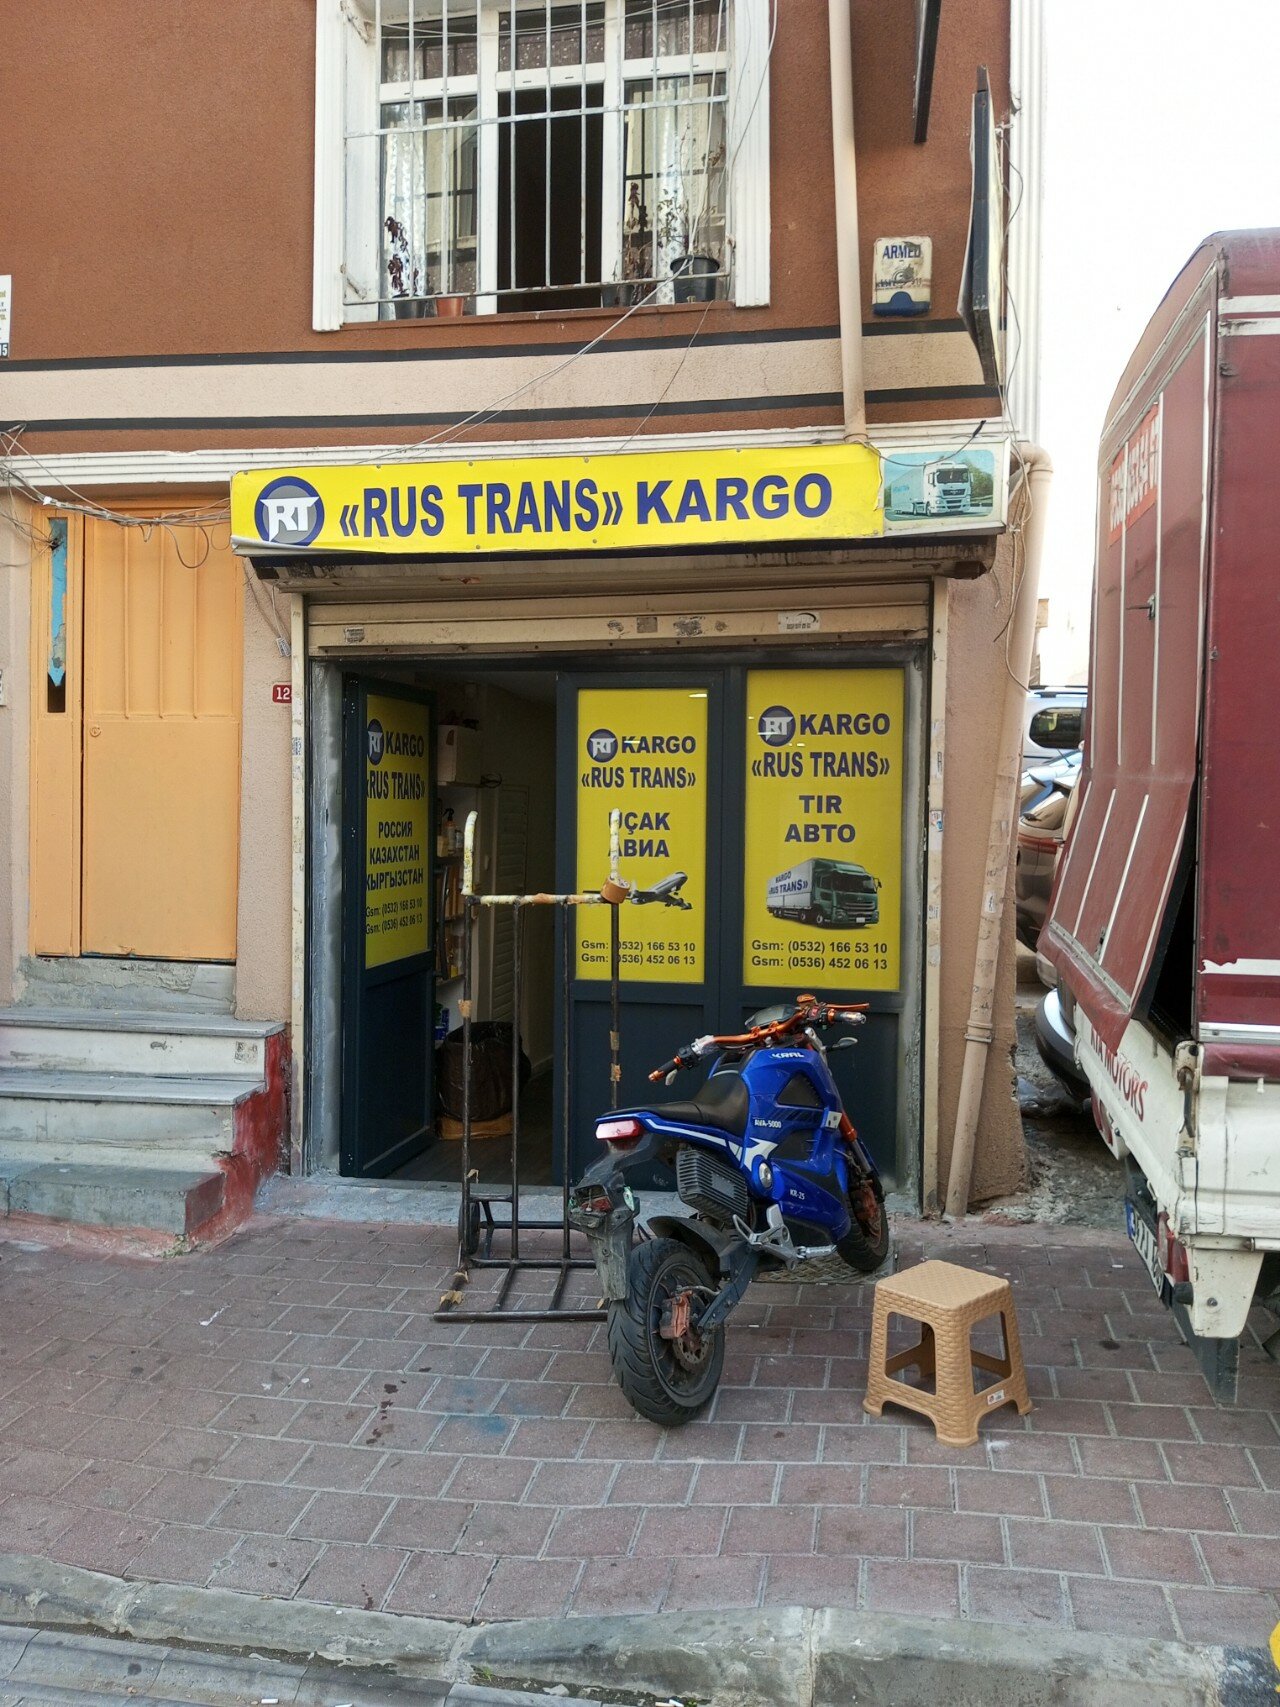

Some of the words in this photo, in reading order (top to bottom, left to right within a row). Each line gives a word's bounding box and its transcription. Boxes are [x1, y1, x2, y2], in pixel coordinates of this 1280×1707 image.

[883, 244, 921, 259] ARMED
[339, 485, 444, 537] «RUS
[458, 478, 624, 535] TRANS»
[636, 472, 832, 525] KARGO
[276, 687, 291, 700] 12
[800, 713, 890, 735] KARGO
[386, 731, 424, 757] KARGO
[621, 736, 696, 754] KARGO
[752, 751, 803, 777] «RUS
[810, 751, 890, 777] TRANS»
[581, 767, 624, 788] «RUS
[630, 767, 696, 788] TRANS»
[799, 795, 843, 814] TIR
[378, 821, 413, 839] РОССИЯ
[369, 844, 420, 865] КАЗАХСТАН
[581, 940, 609, 949] Gsm:
[647, 942, 665, 950] 166
[668, 942, 680, 951] 53
[684, 943, 696, 952] 10
[752, 939, 784, 950] Gsm:
[788, 940, 825, 955] (0532)
[829, 942, 851, 953] 166
[854, 943, 869, 953] 53
[873, 943, 888, 954] 10
[581, 953, 609, 962] Gsm:
[646, 955, 665, 964] 452
[668, 955, 680, 964] 06
[684, 956, 696, 965] 13
[752, 955, 784, 966] Gsm:
[788, 956, 825, 970] (0536)
[829, 958, 851, 969] 452
[854, 959, 869, 969] 06
[873, 959, 888, 970] 13
